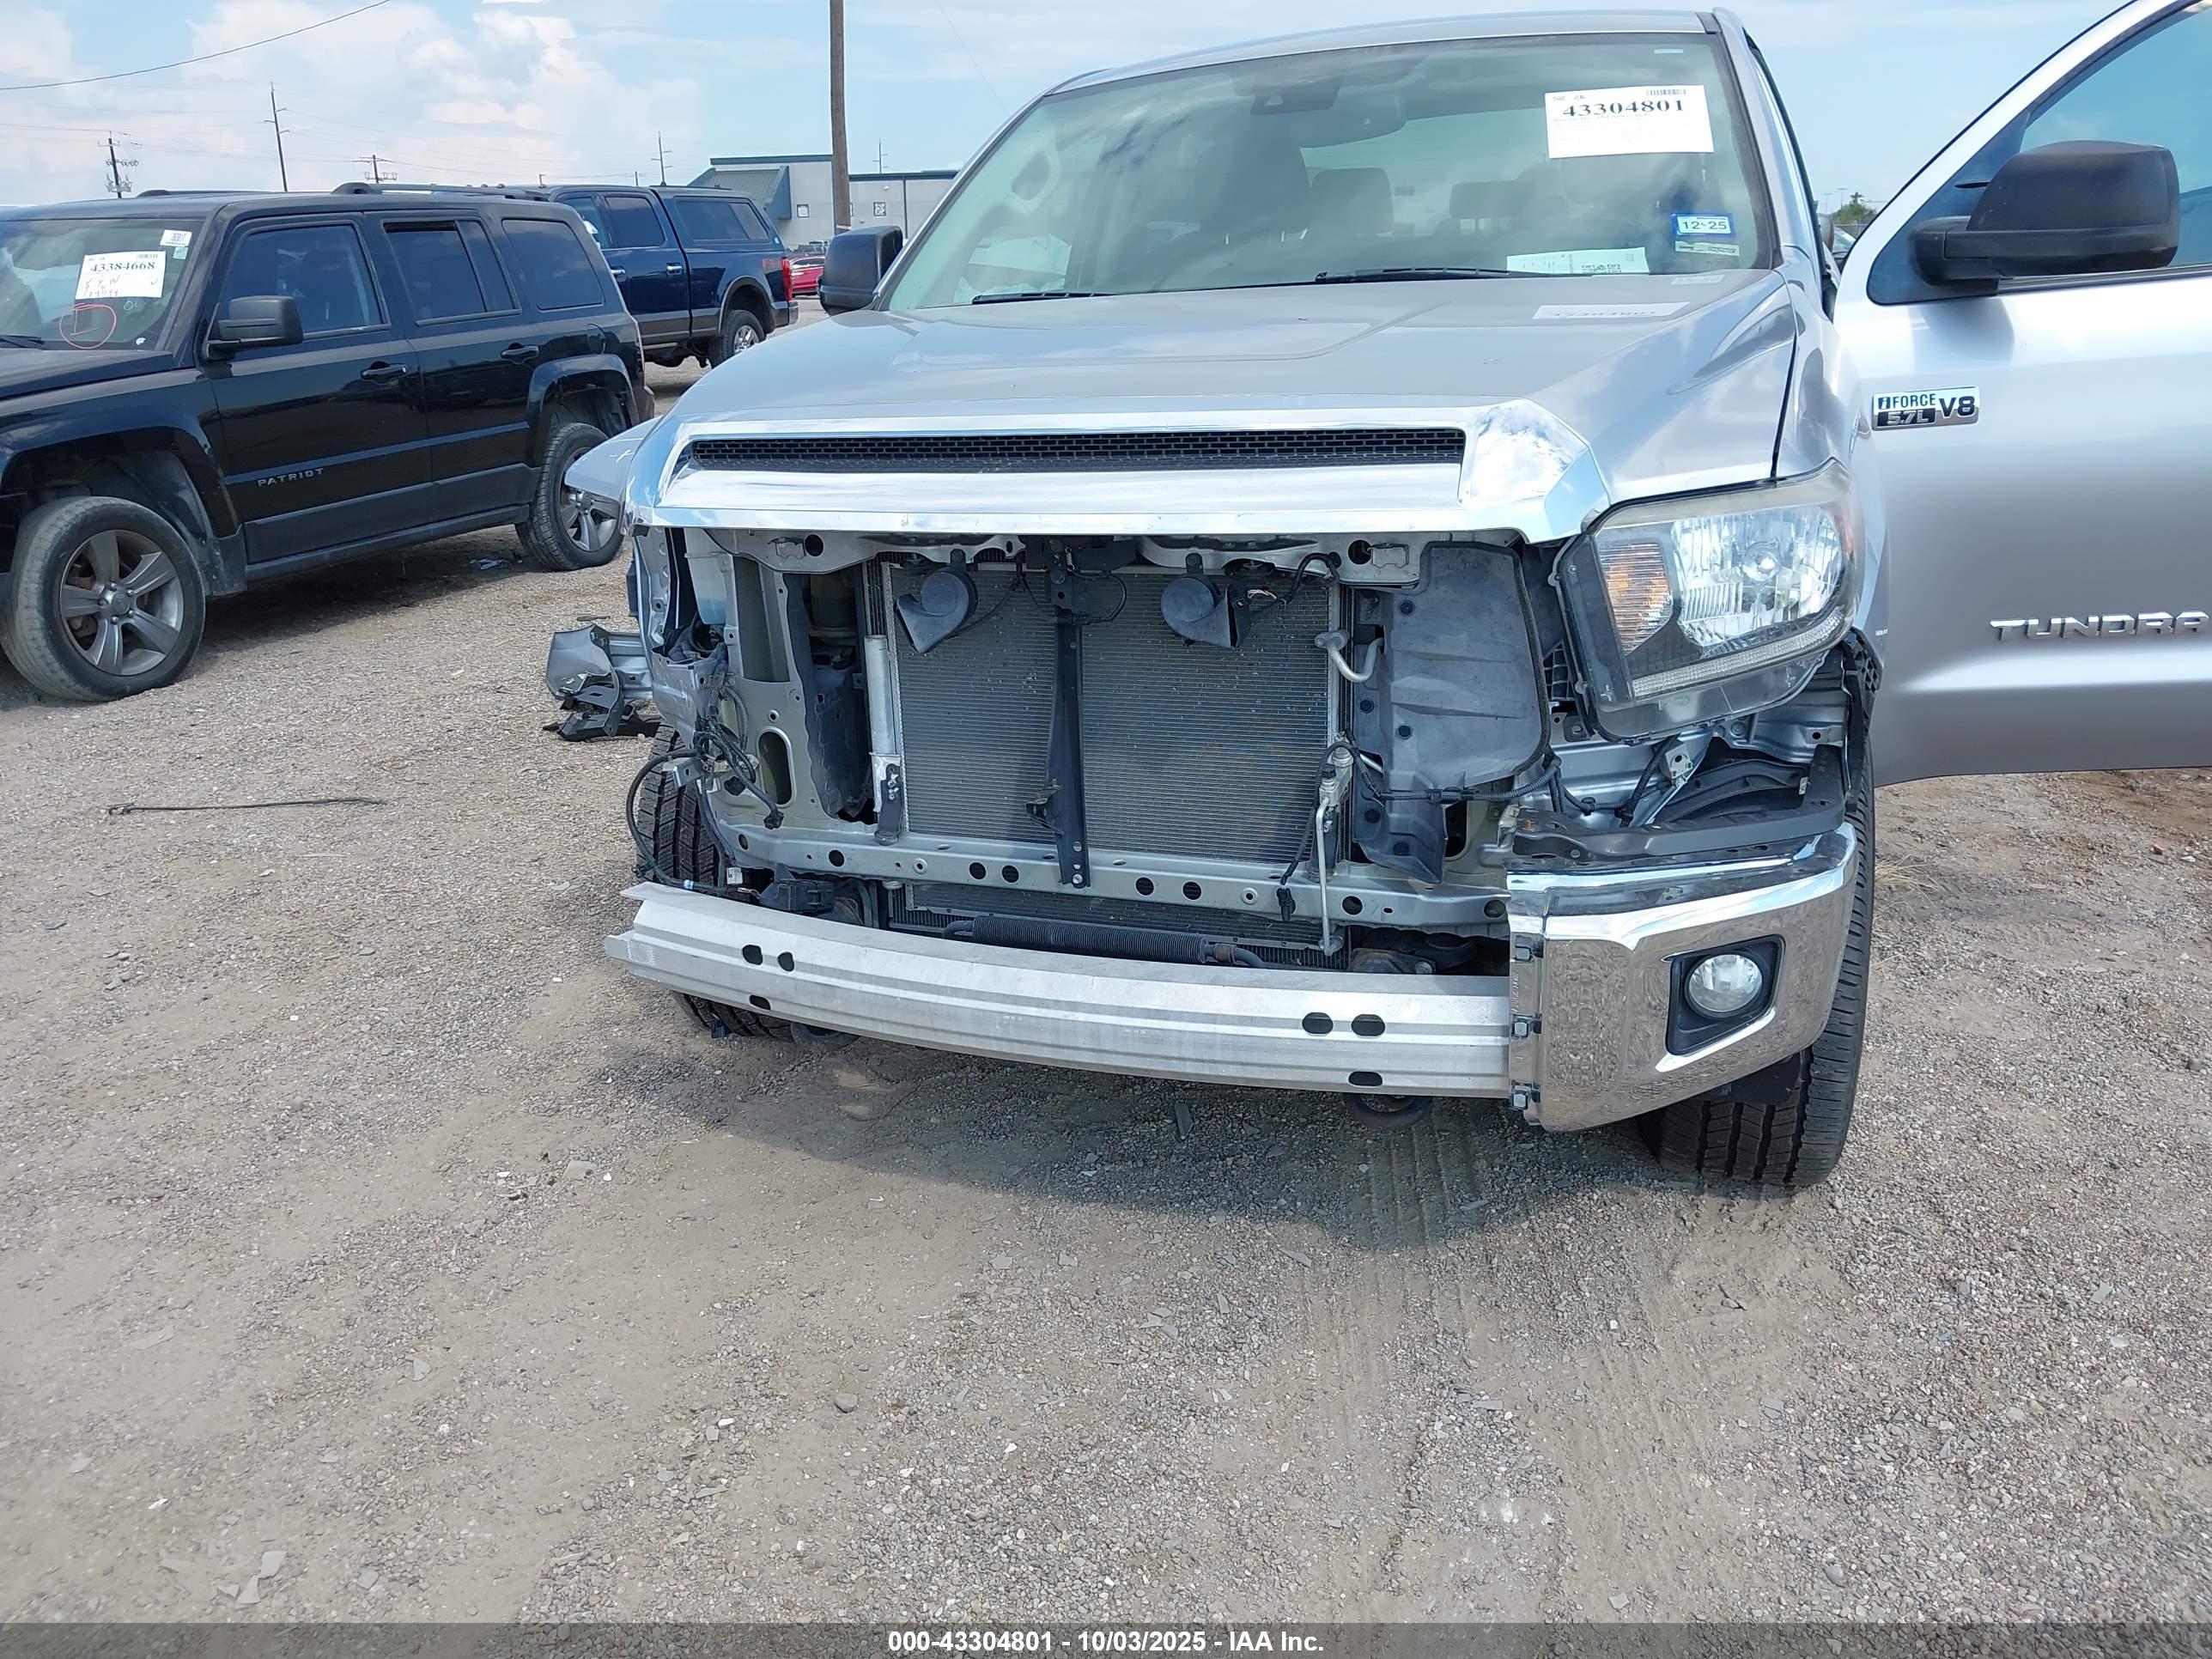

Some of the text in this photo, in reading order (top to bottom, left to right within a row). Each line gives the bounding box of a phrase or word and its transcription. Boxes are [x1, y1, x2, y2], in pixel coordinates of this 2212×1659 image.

[1562, 99, 1684, 118] 43304801
[90, 261, 156, 273] 43384668
[1938, 395, 1976, 418] V8
[1887, 410, 1929, 425] 5.7L
[258, 467, 324, 487] PATRIOT
[1990, 611, 2210, 641] TUNDRA
